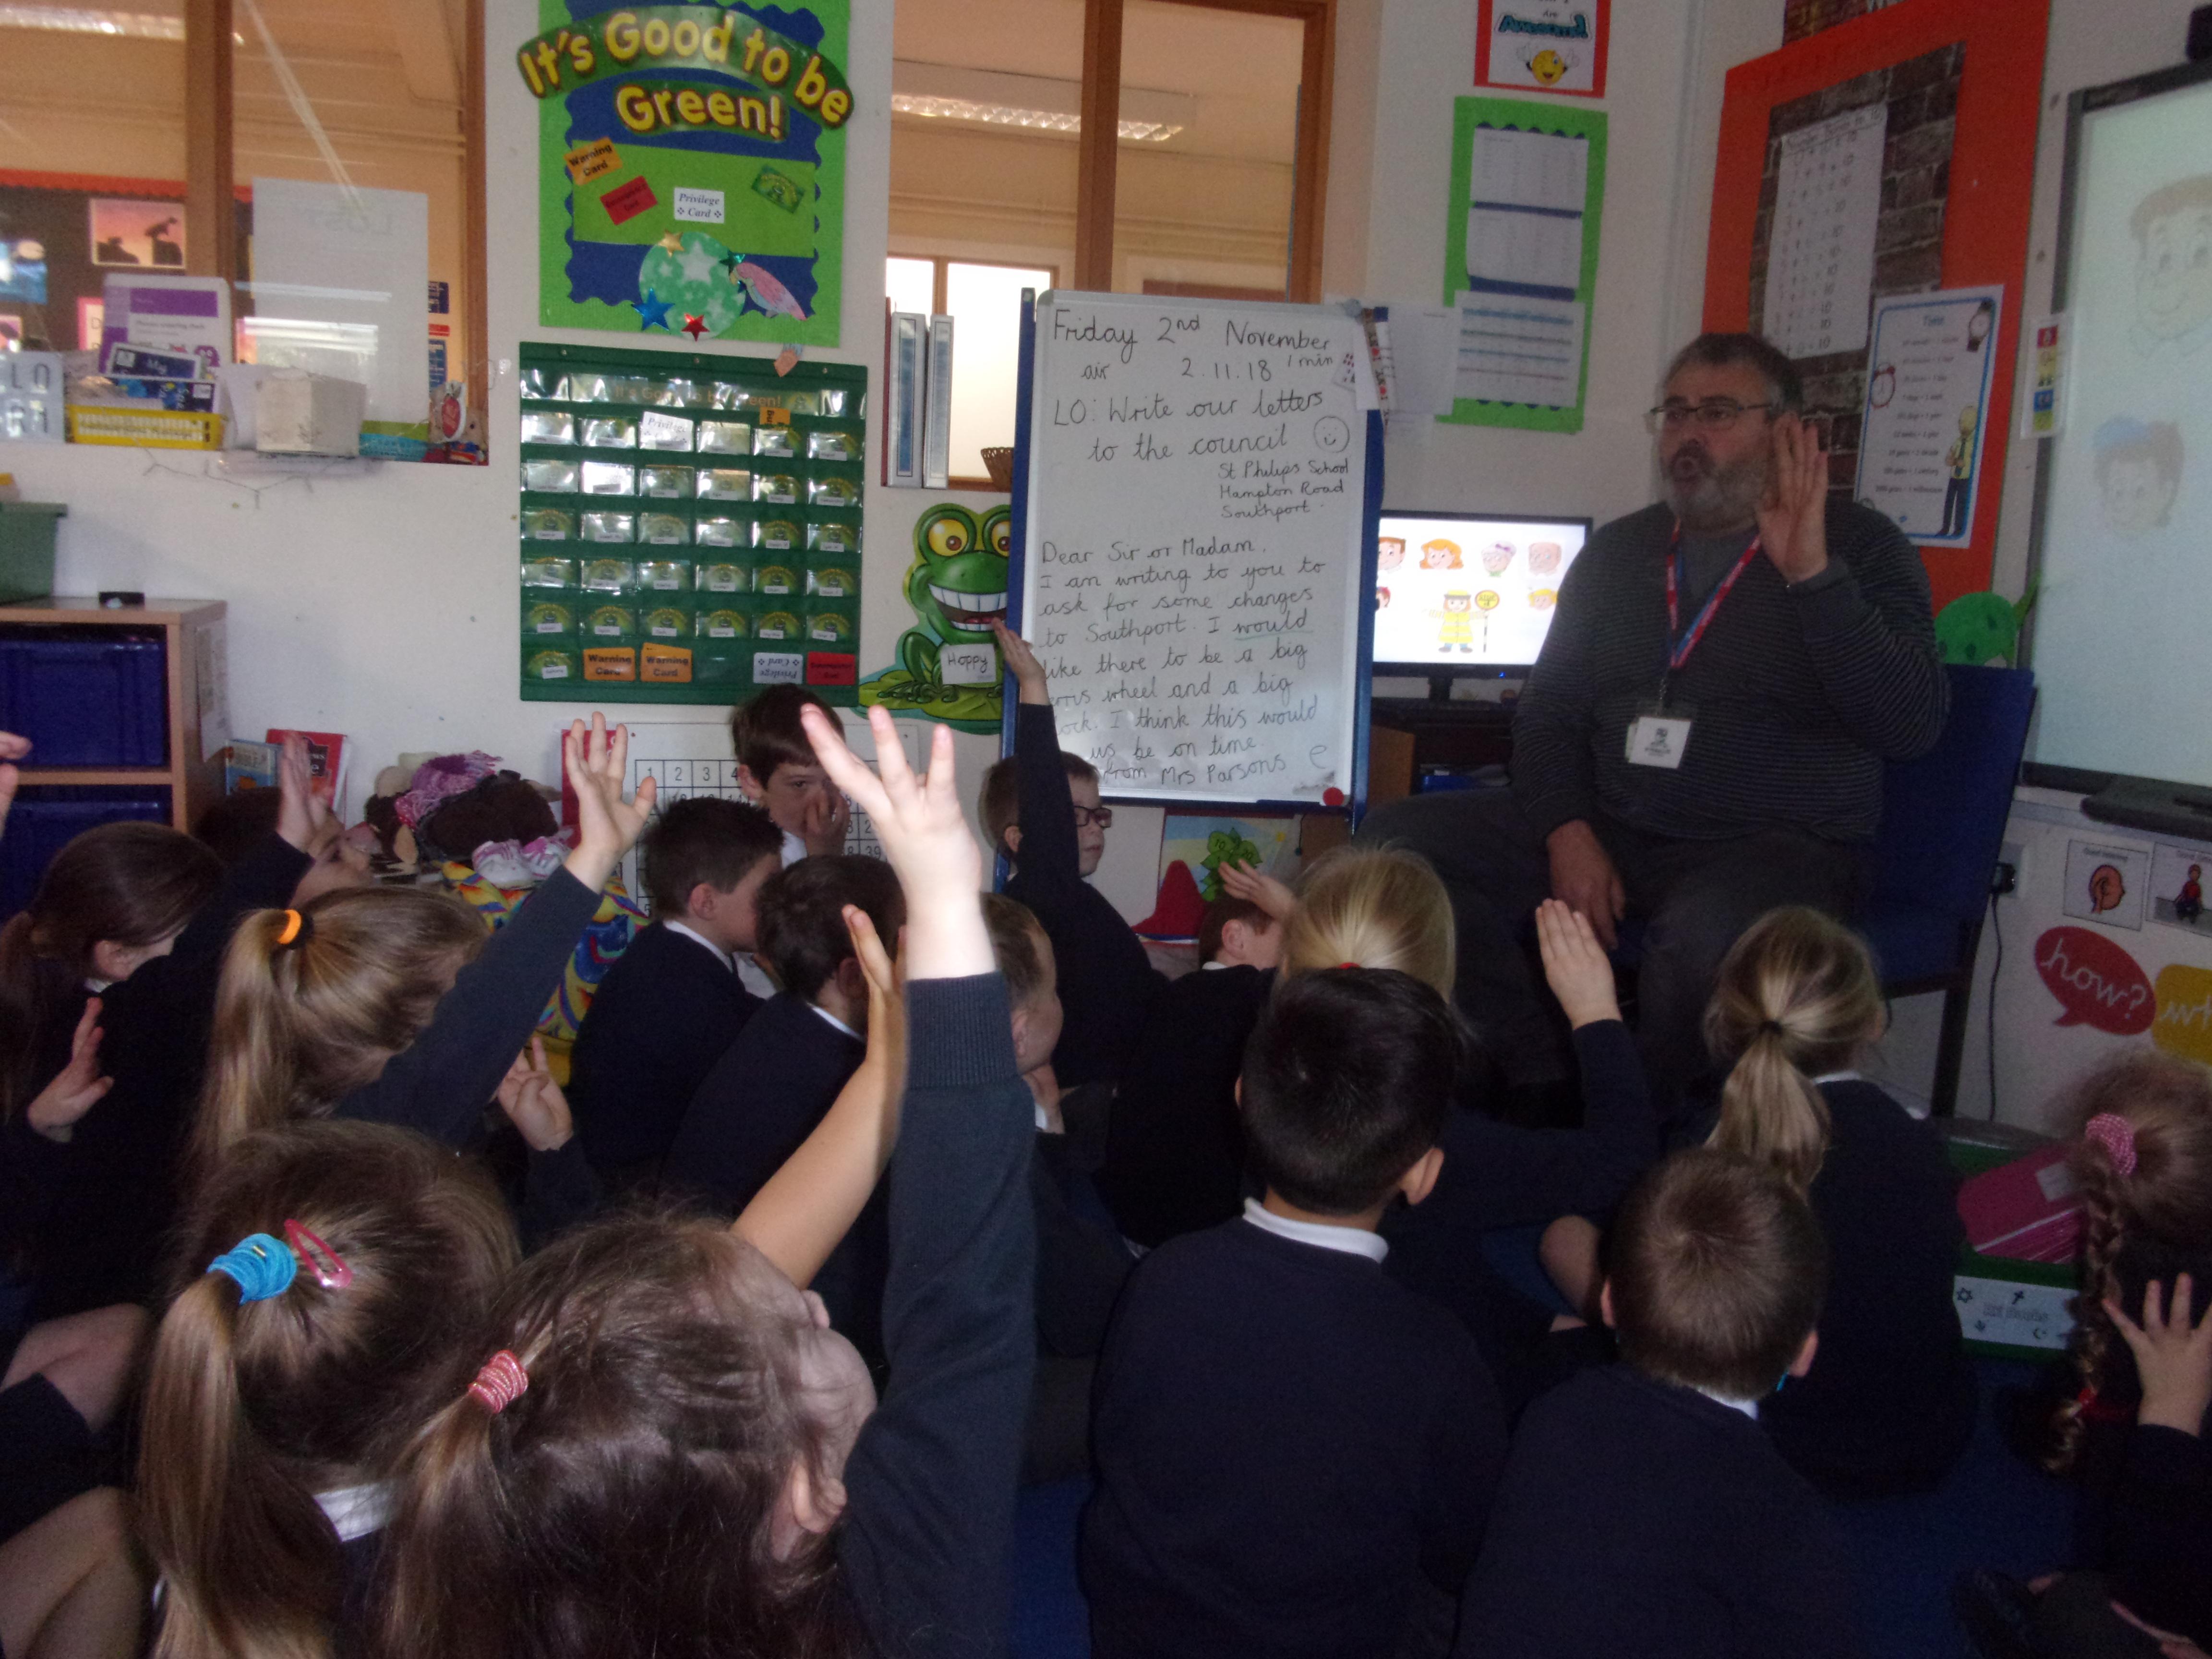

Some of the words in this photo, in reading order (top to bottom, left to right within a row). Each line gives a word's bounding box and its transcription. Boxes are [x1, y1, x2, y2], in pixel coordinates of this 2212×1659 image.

[520, 31, 594, 96] It's
[605, 12, 734, 61] Good
[743, 28, 790, 83] to
[795, 55, 849, 123] be
[616, 84, 781, 140] Green!
[569, 144, 613, 167] Warning
[583, 160, 608, 177] Card
[679, 193, 720, 206] Privilege
[688, 207, 711, 218] Card
[1054, 309, 1138, 364] Friday
[1157, 315, 1200, 343] 2nd
[1226, 320, 1329, 349] November
[1081, 364, 1109, 379] air
[1299, 358, 1333, 366] min
[1109, 393, 1173, 422] Write
[1186, 399, 1237, 417] our
[1252, 389, 1324, 419] letters
[1088, 438, 1118, 462] to
[1133, 433, 1172, 460] the
[1189, 423, 1286, 455] council
[1220, 463, 1235, 479] St
[1308, 459, 1348, 474] School
[1220, 483, 1292, 505] Hampton
[1301, 479, 1344, 495] Road
[1042, 541, 1093, 564] Dear
[1108, 541, 1140, 561] Sir
[1147, 547, 1170, 558] or
[1065, 576, 1101, 588] am
[1116, 566, 1190, 593] writing
[1206, 564, 1228, 580] to
[1241, 565, 1284, 590] you
[1298, 557, 1325, 573] to
[1039, 595, 1087, 616] ask
[1103, 594, 1138, 622] for
[1152, 596, 1212, 609] some
[1228, 586, 1312, 615] changes
[1039, 629, 1067, 648] to
[1233, 611, 1307, 634] would
[588, 654, 632, 665] Warning
[647, 656, 689, 666] Warning
[948, 652, 988, 673] Hoppy
[1045, 658, 1082, 680] like
[1096, 653, 1146, 673] there
[1162, 647, 1187, 669] to
[1199, 645, 1222, 663] be
[1270, 637, 1307, 670] big
[653, 668, 678, 677] Card
[1102, 676, 1157, 702] wheel
[1168, 673, 1210, 698] and
[1253, 670, 1293, 707] big
[1136, 706, 1189, 729] think
[1202, 704, 1246, 728] this
[1258, 695, 1317, 725] would
[1090, 744, 1115, 759] us
[1134, 738, 1154, 760] be
[1170, 742, 1196, 757] on
[674, 767, 683, 781] 2
[702, 767, 711, 782] 3
[1104, 758, 1146, 783] from
[1161, 768, 1195, 785] Mrs
[1208, 754, 1286, 783] Parsons
[2040, 938, 2147, 1020] how?
